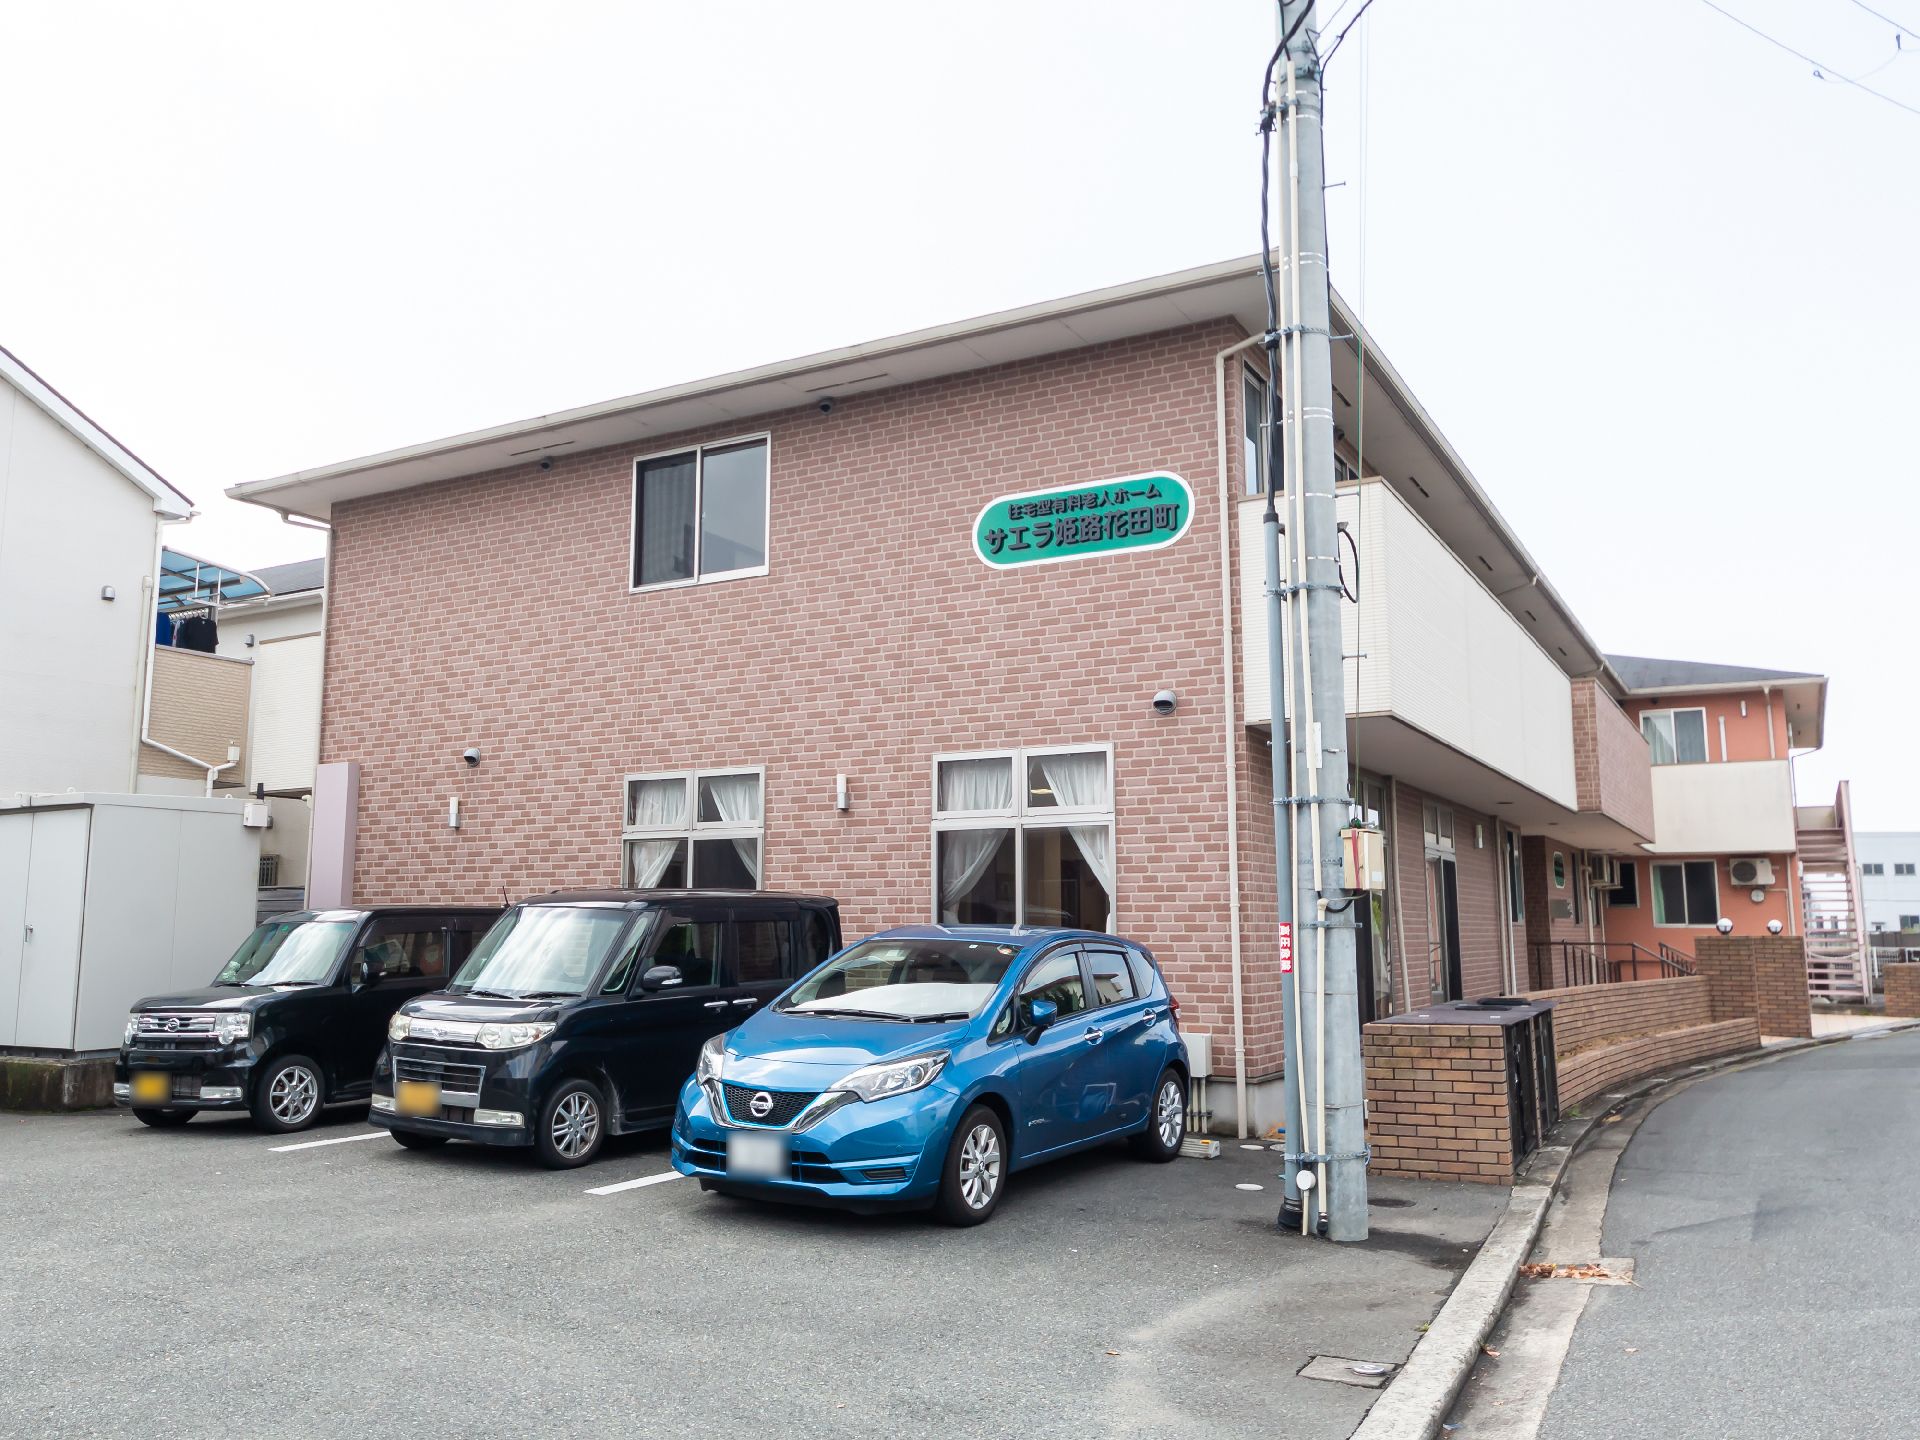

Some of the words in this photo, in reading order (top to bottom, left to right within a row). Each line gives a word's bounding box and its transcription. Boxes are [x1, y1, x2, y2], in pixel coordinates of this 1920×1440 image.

[1008, 482, 1162, 520] 住宅型有料老人ホーム
[984, 503, 1180, 554] サエラ姫路花田町
